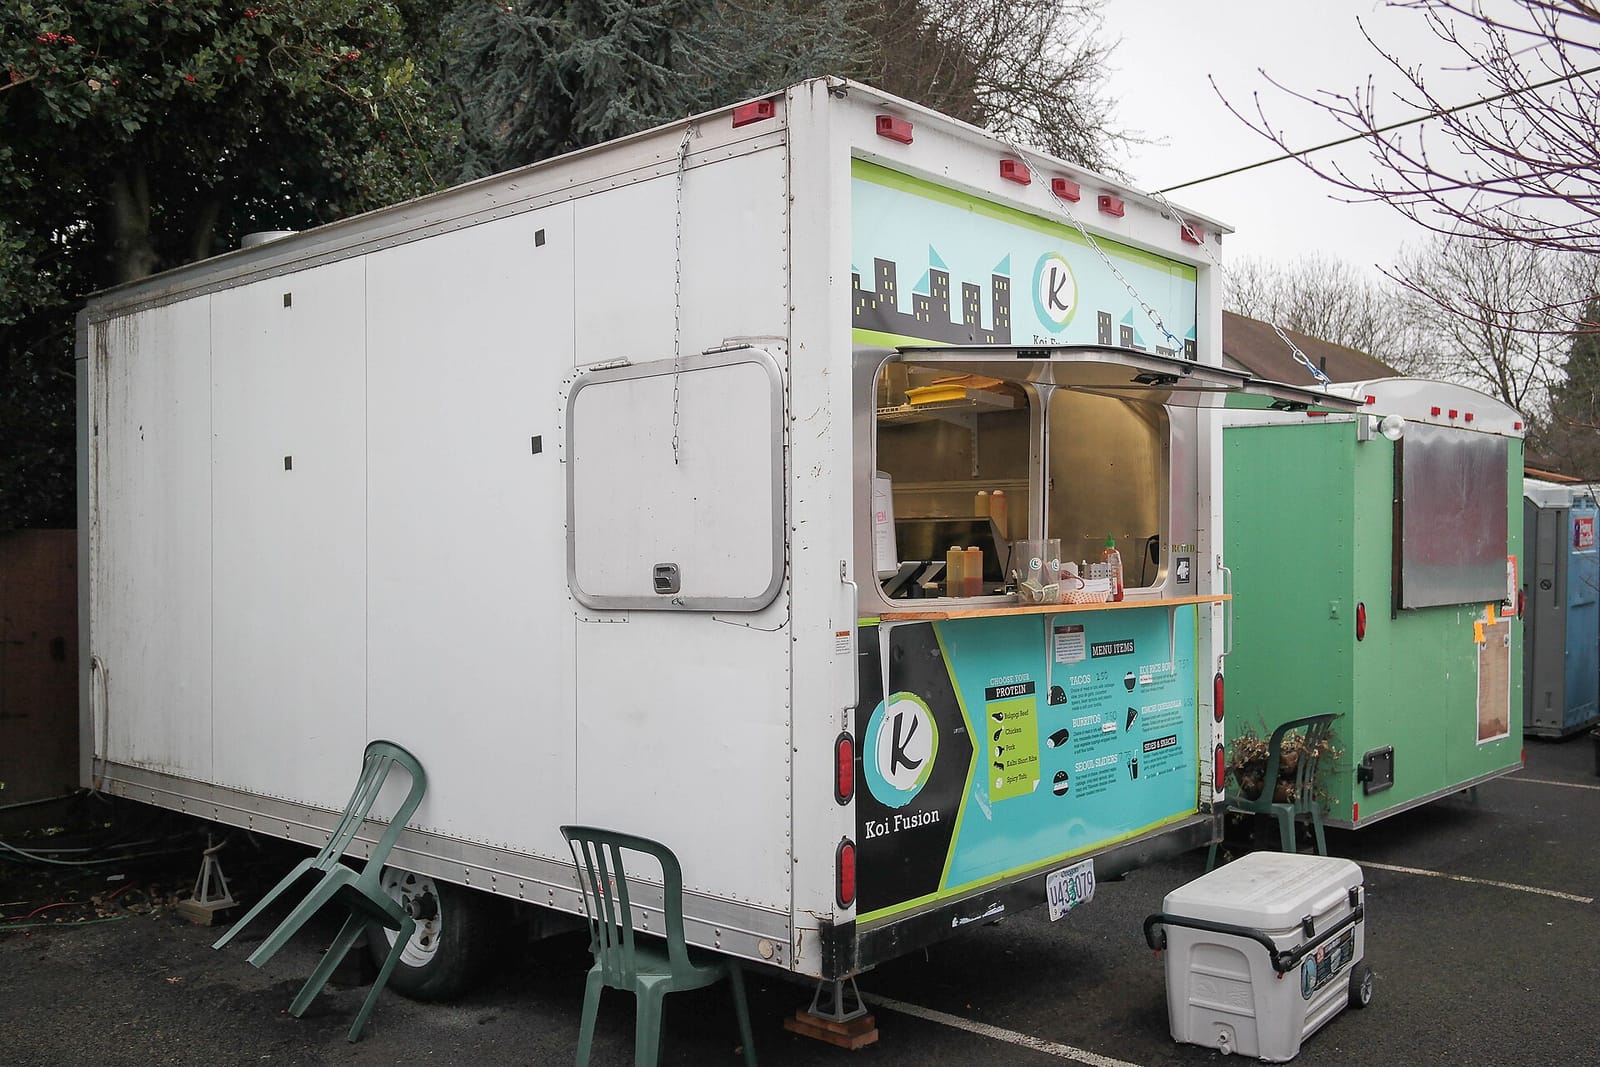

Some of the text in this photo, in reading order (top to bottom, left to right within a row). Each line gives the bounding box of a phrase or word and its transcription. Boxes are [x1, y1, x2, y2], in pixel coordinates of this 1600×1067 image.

[1048, 267, 1069, 311] K
[1092, 642, 1134, 656] MENU ITEMS
[990, 673, 1030, 686] CHOOSE YOUR
[1070, 674, 1091, 686] TACOS
[996, 684, 1026, 697] PROTEIN
[1020, 708, 1029, 717] Beef
[1072, 713, 1101, 728] BURRITOS
[1005, 727, 1022, 735] Chicken
[890, 712, 924, 776] K
[1006, 744, 1016, 752] Pork
[1144, 741, 1156, 752] SIDES
[1075, 760, 1095, 772] SEOUL
[1095, 754, 1118, 767] SLIDERS
[865, 809, 940, 839] Koi Fusion
